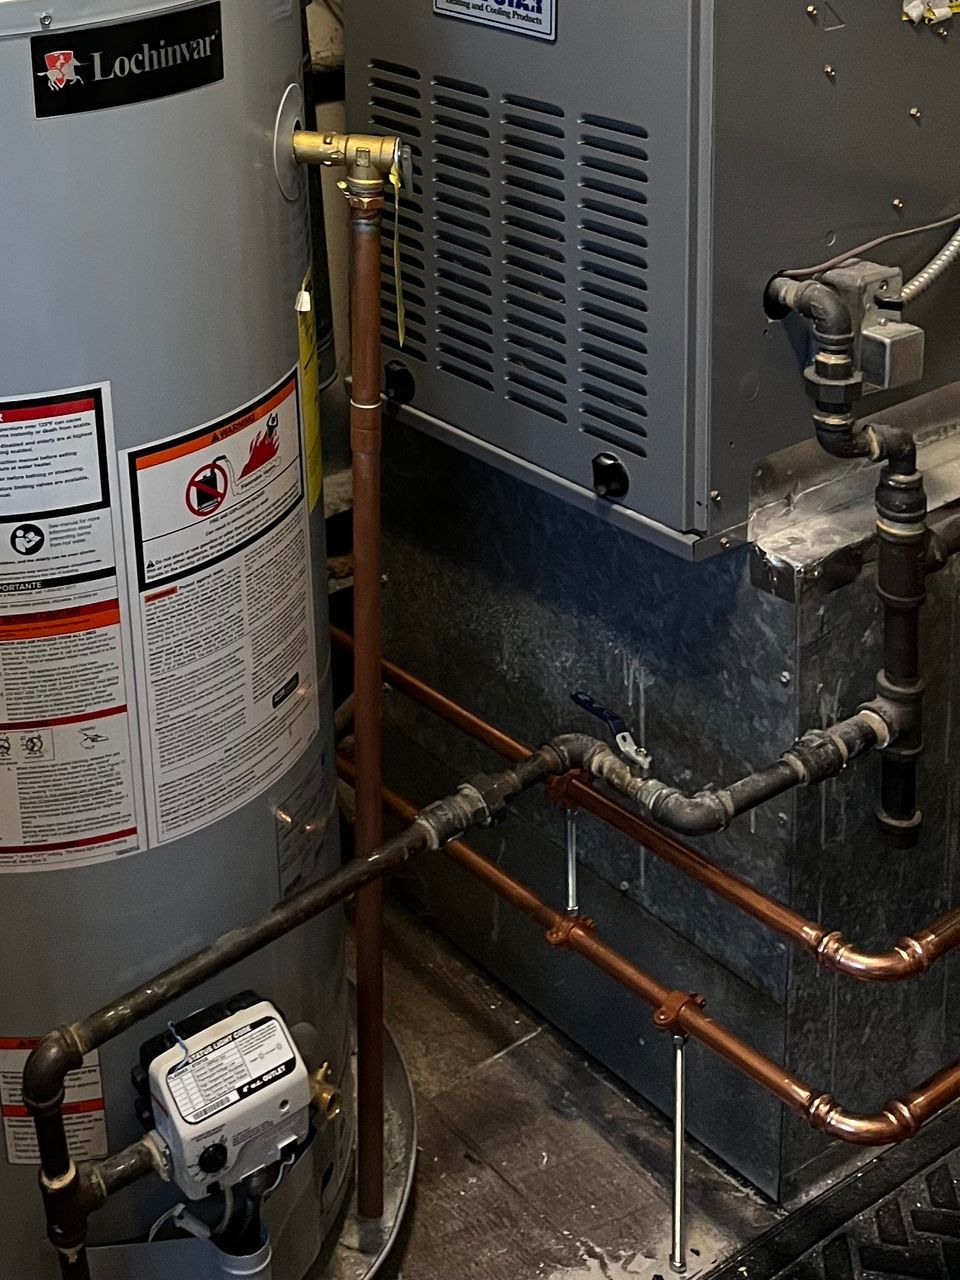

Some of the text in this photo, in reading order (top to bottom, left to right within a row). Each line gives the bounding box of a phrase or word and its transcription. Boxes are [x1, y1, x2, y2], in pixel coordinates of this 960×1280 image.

[472, 2, 484, 11] and
[485, 5, 511, 19] Cooling
[512, 12, 542, 25] Products
[90, 36, 216, 82] Lochinvar
[262, 1065, 286, 1082] OUTLET
